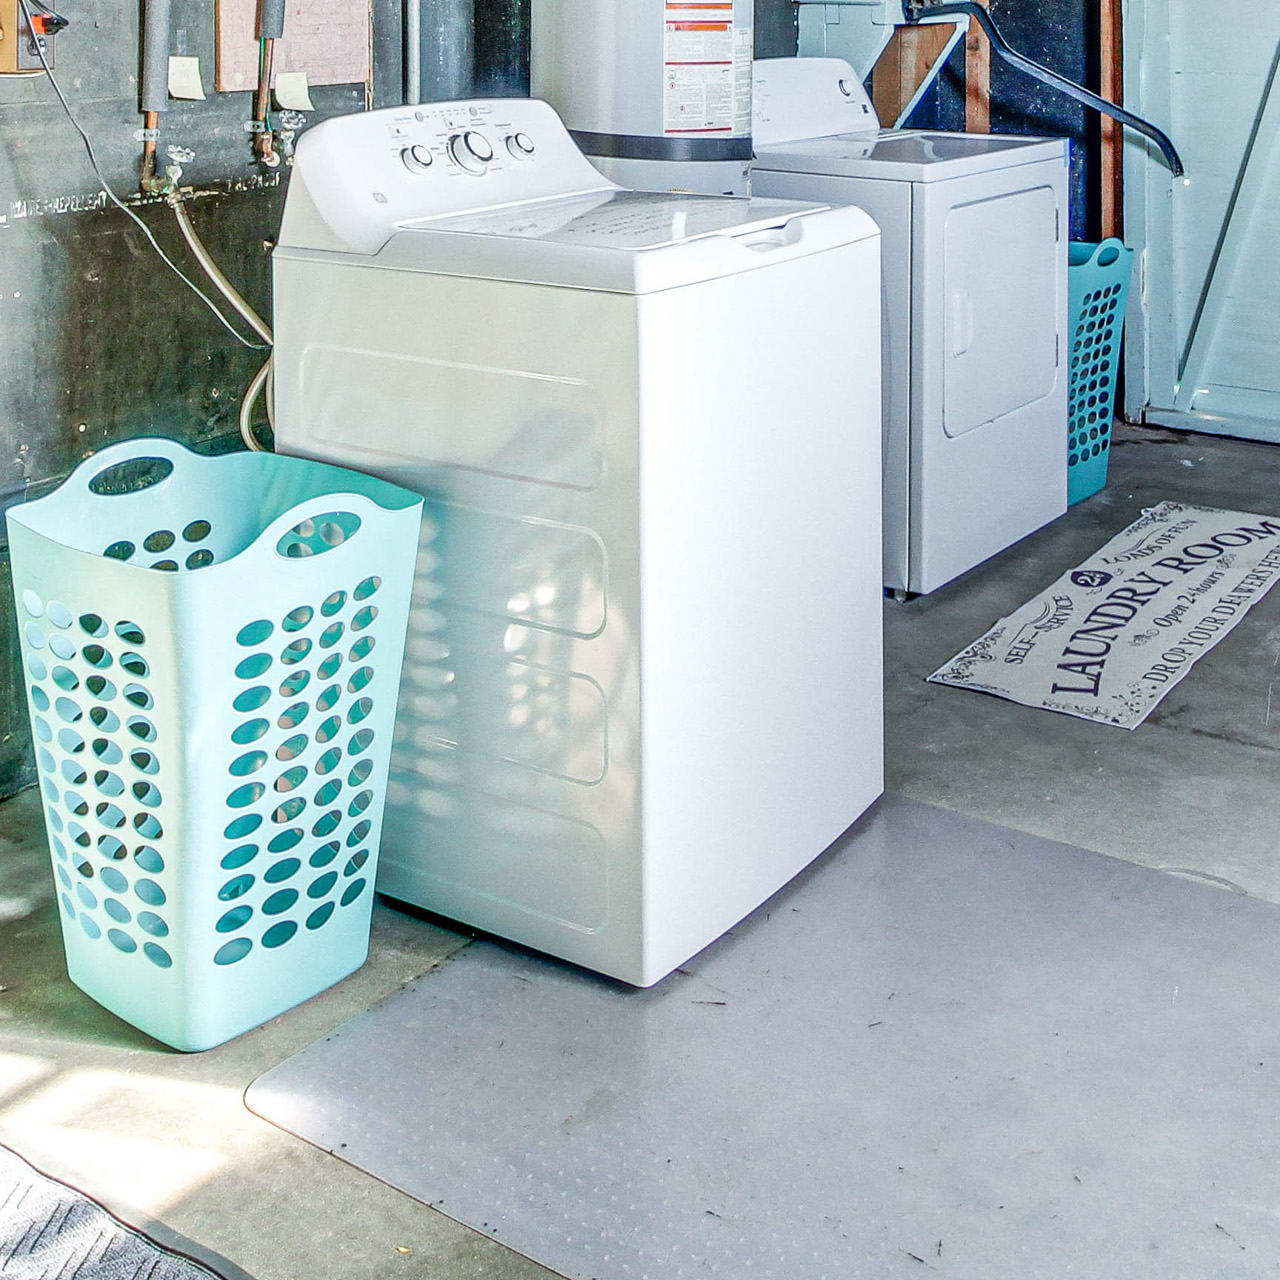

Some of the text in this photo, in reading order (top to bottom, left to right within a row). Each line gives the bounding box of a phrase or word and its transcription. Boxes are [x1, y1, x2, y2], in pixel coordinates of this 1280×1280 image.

[1101, 519, 1199, 565] LOADS OF FUN
[1004, 594, 1074, 665] SELF-SERVICE
[1051, 571, 1174, 697] LAUNDRY
[1142, 646, 1194, 683] DROP
[1178, 616, 1229, 647] YOUR
[1152, 603, 1190, 629] Open
